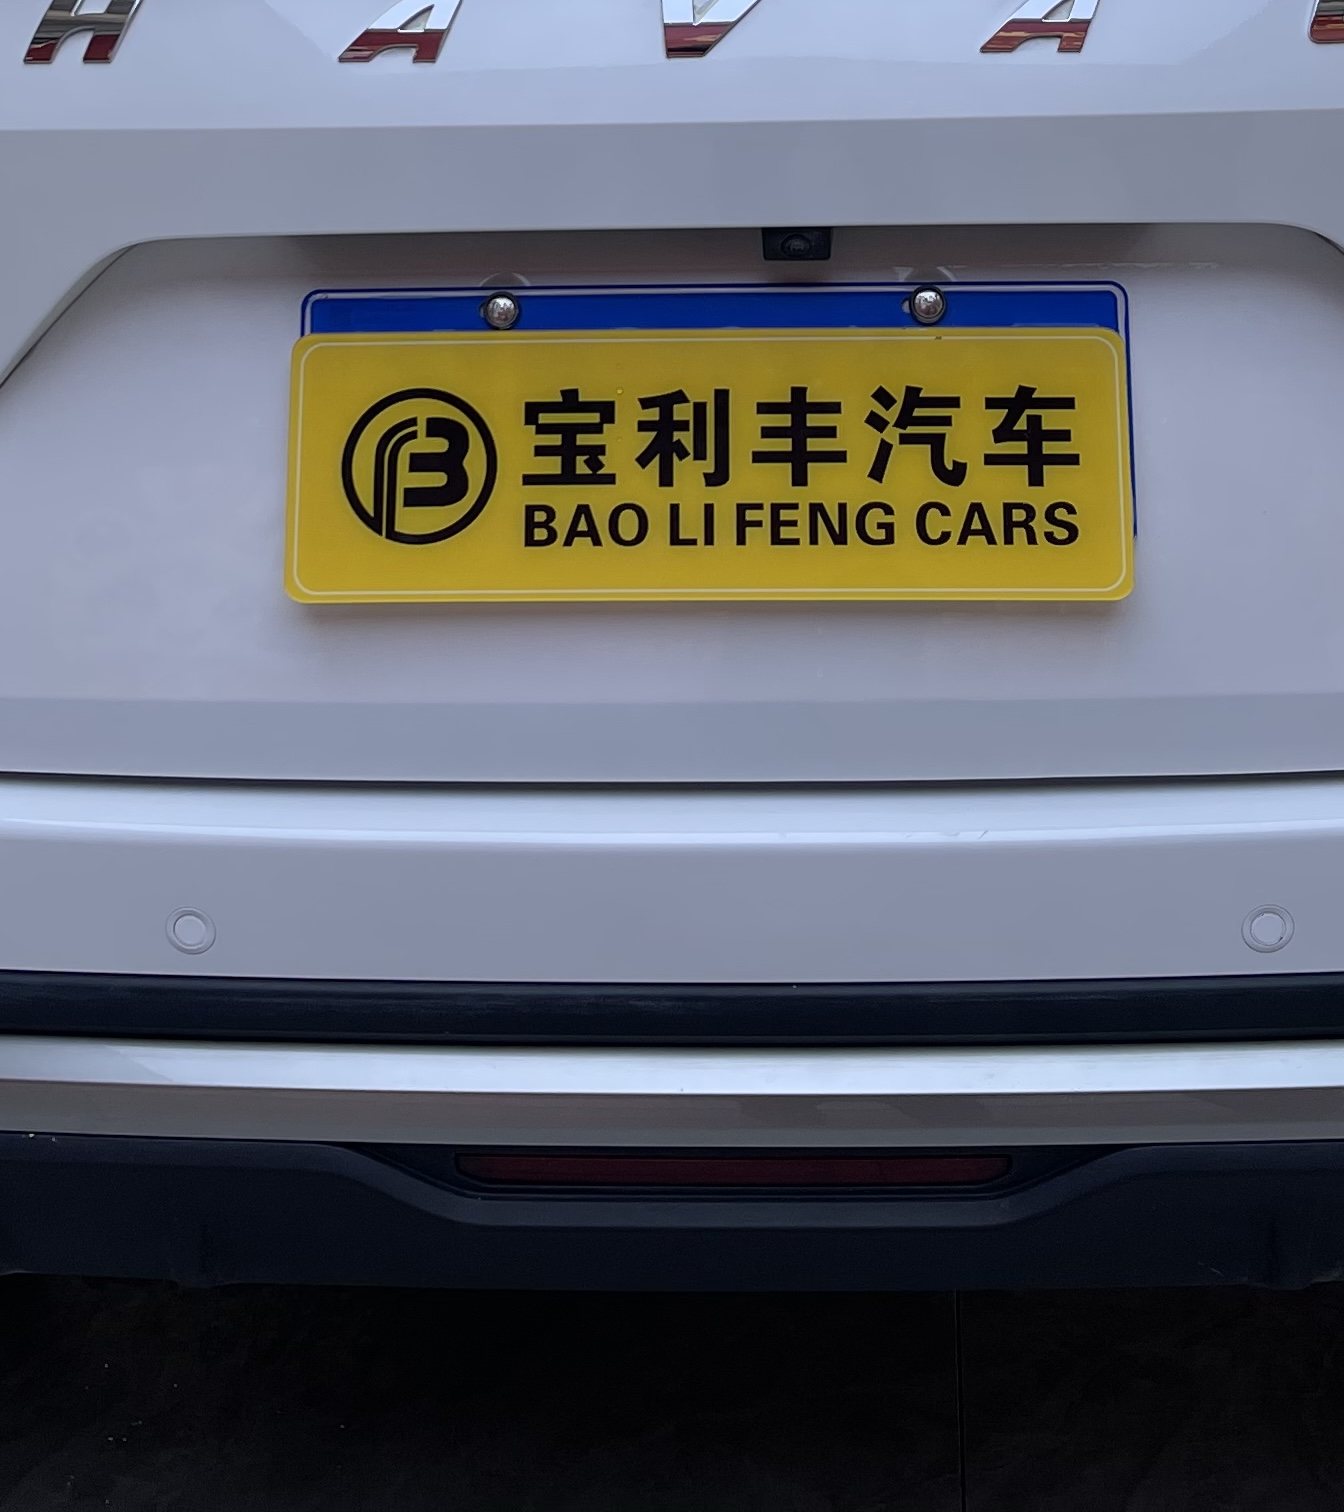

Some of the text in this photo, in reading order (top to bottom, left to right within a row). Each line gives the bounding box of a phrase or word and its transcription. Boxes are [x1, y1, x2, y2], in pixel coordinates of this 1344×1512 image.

[522, 385, 1081, 488] 宝利丰汽车
[523, 500, 1080, 548] BAO LI FENG CARS
